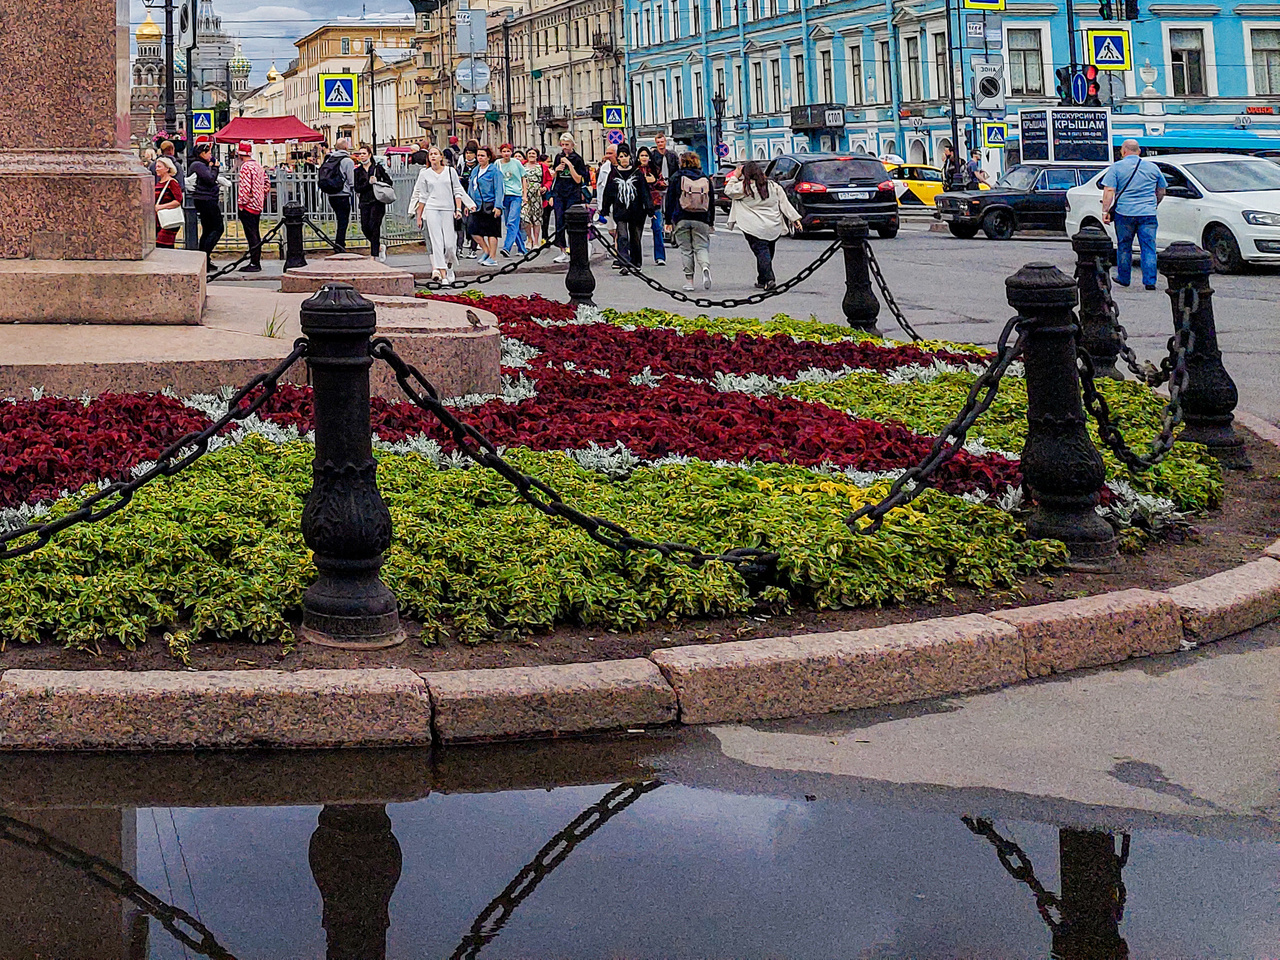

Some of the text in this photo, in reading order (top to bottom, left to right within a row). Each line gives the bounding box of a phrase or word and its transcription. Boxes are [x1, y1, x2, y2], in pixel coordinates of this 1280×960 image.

[828, 112, 841, 123] СТОП
[1052, 112, 1095, 120] ЭКСКУРСИИ
[1095, 112, 1107, 120] ПО
[1054, 120, 1105, 130] КРЫШАМ
